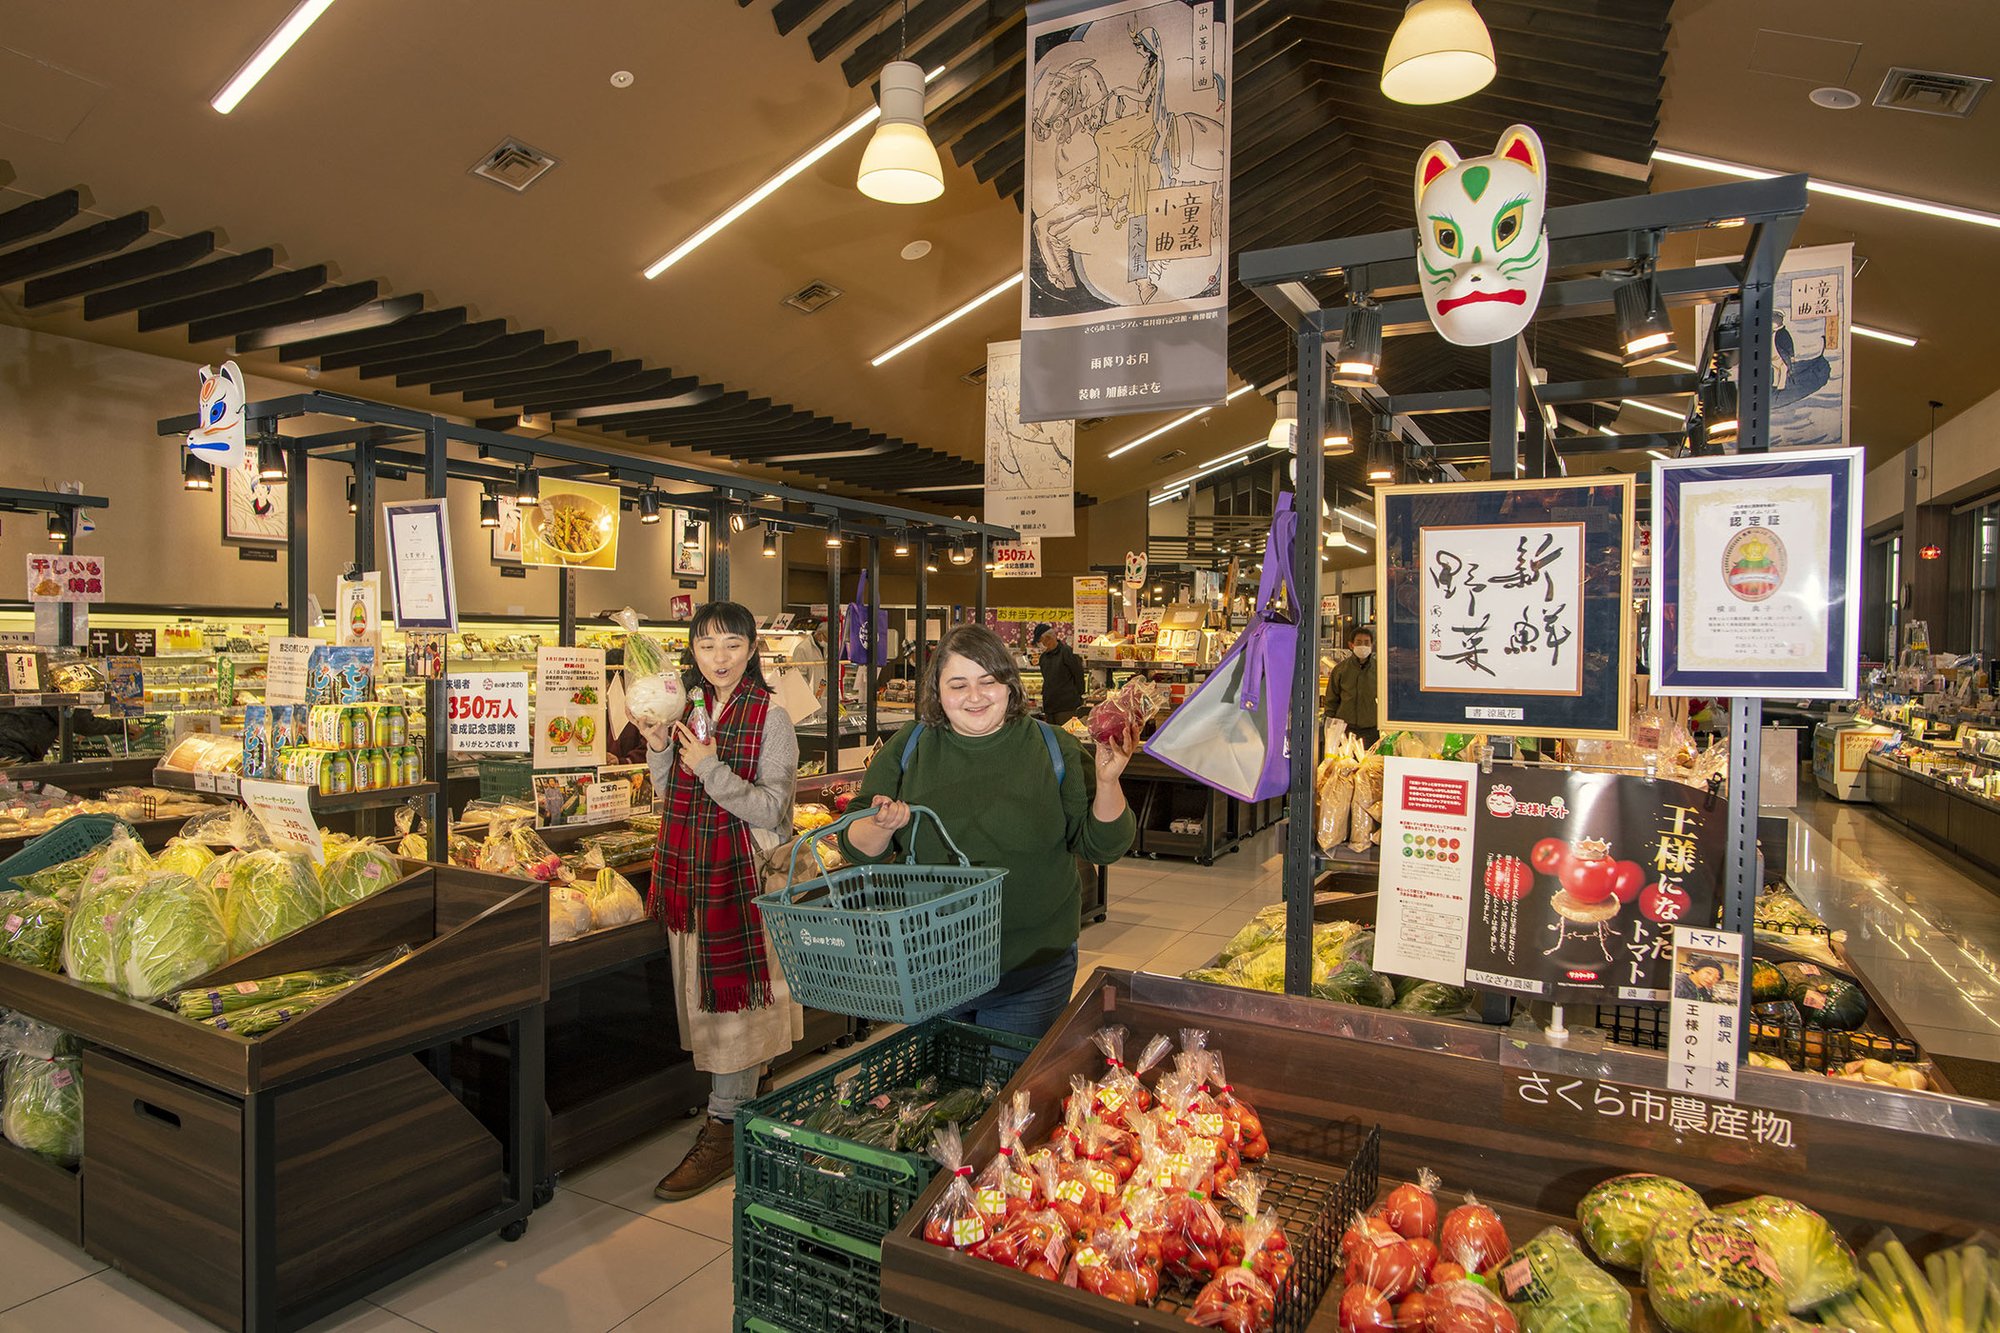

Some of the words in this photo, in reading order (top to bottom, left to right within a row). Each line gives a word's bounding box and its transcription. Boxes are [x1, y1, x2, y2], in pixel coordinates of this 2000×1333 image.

[1090, 352, 1150, 370] 雨降りお月
[1105, 381, 1162, 399] 加藤まさを
[1729, 514, 1780, 527] 認定証
[31, 559, 101, 576] 干しいも
[92, 632, 153, 654] 干し芋
[448, 695, 519, 719] 350万人
[450, 723, 516, 735] 達成記念感謝祭
[459, 740, 520, 748] ありがとうございます
[1515, 802, 1570, 819] 王様トマト
[1652, 803, 1700, 961] 王様になった
[1690, 931, 1727, 948] トマト
[1626, 920, 1651, 984] トマト
[1475, 974, 1534, 991] いなざわ農園
[1684, 1004, 1700, 1089] 王様のトマト
[1714, 1060, 1730, 1088] 雄大
[1517, 1071, 1794, 1148] さくら市農産物
